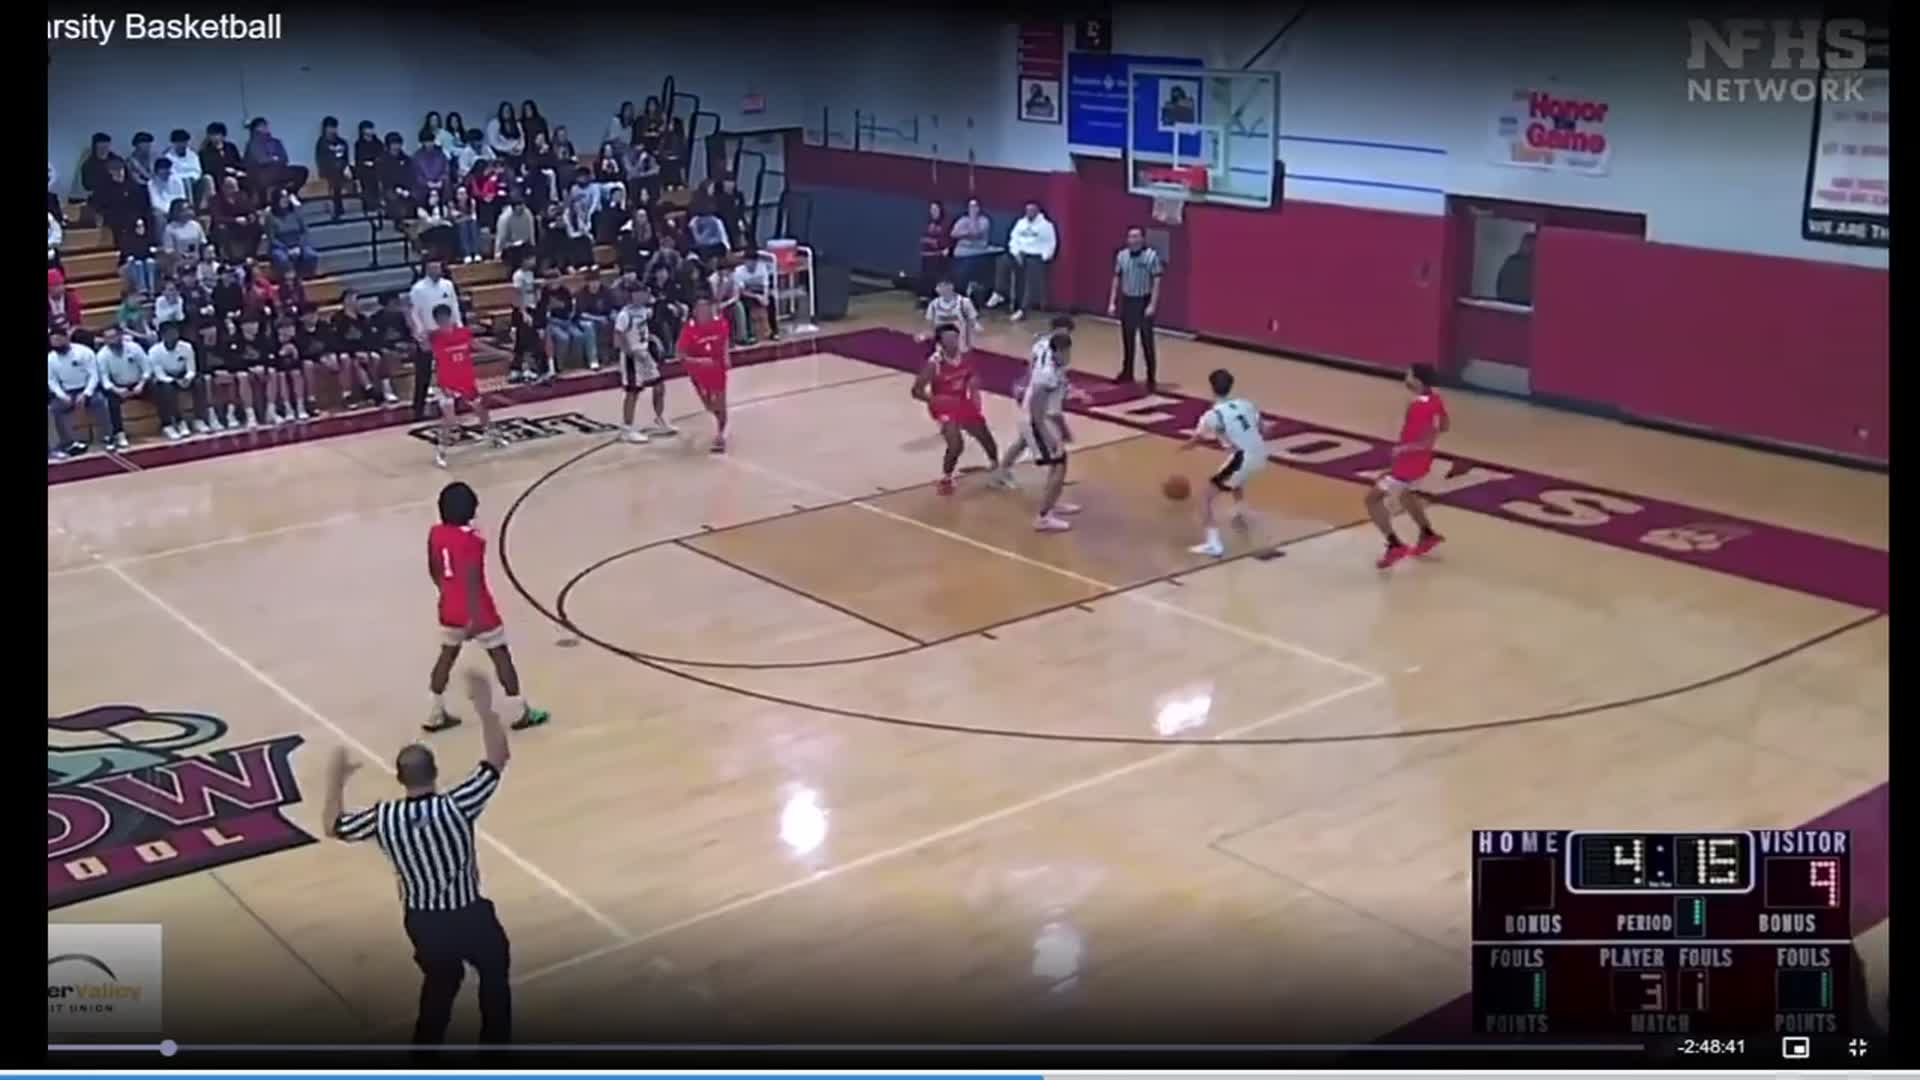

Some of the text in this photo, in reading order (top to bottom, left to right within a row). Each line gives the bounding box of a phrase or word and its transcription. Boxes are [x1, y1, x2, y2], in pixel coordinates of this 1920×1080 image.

[1529, 91, 1609, 122] Honor
[1526, 122, 1606, 154] Game
[1836, 222, 1867, 238] ARE
[441, 547, 454, 577] 1
